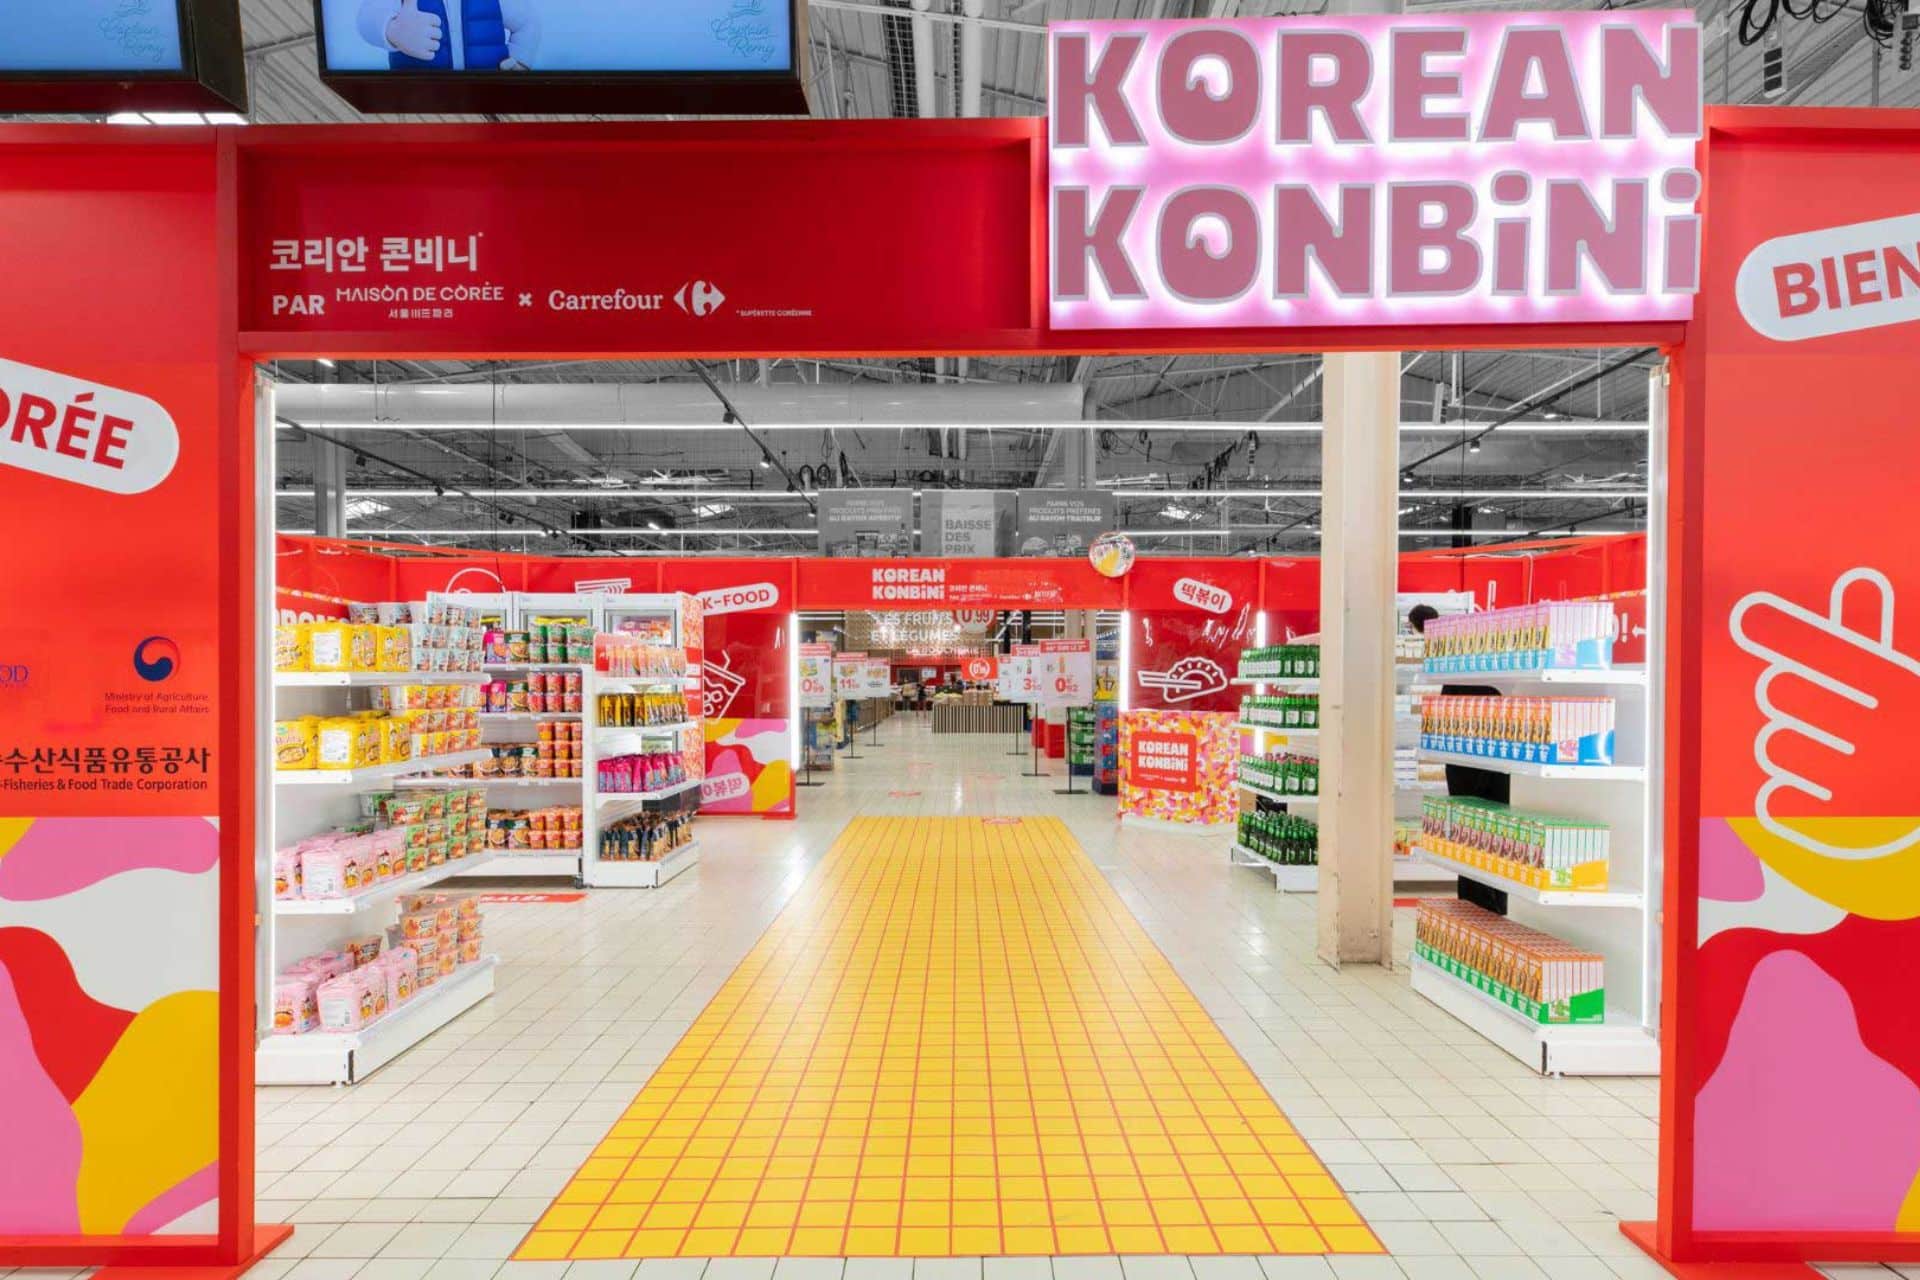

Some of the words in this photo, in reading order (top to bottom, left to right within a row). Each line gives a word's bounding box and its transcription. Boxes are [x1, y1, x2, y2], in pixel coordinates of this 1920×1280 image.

[1053, 23, 1703, 149] KOREAN
[1053, 167, 1702, 304] KONBiNi
[270, 236, 368, 272] 코리안
[413, 286, 435, 301] DE
[548, 288, 664, 311] Carrefour
[272, 294, 325, 315] PAR
[0, 387, 134, 470] RÉE
[945, 519, 993, 530] BAISSE
[945, 531, 971, 542] DES
[944, 544, 977, 553] PRIX
[872, 568, 946, 583] KOREAN
[703, 589, 770, 610] K-FOOD
[1182, 583, 1226, 610] 떡볶이
[104, 692, 142, 702] Ministry
[144, 692, 154, 701] of
[105, 704, 128, 713] Food
[132, 704, 150, 713] and
[152, 704, 177, 713] Rural
[179, 704, 209, 713] Affairs
[1138, 740, 1189, 756] KOREAN
[0, 747, 211, 774] 수산식품유통공사
[57, 779, 66, 790] &
[68, 778, 97, 790] Food
[102, 778, 133, 790] Trade
[136, 778, 208, 792] Corporation
